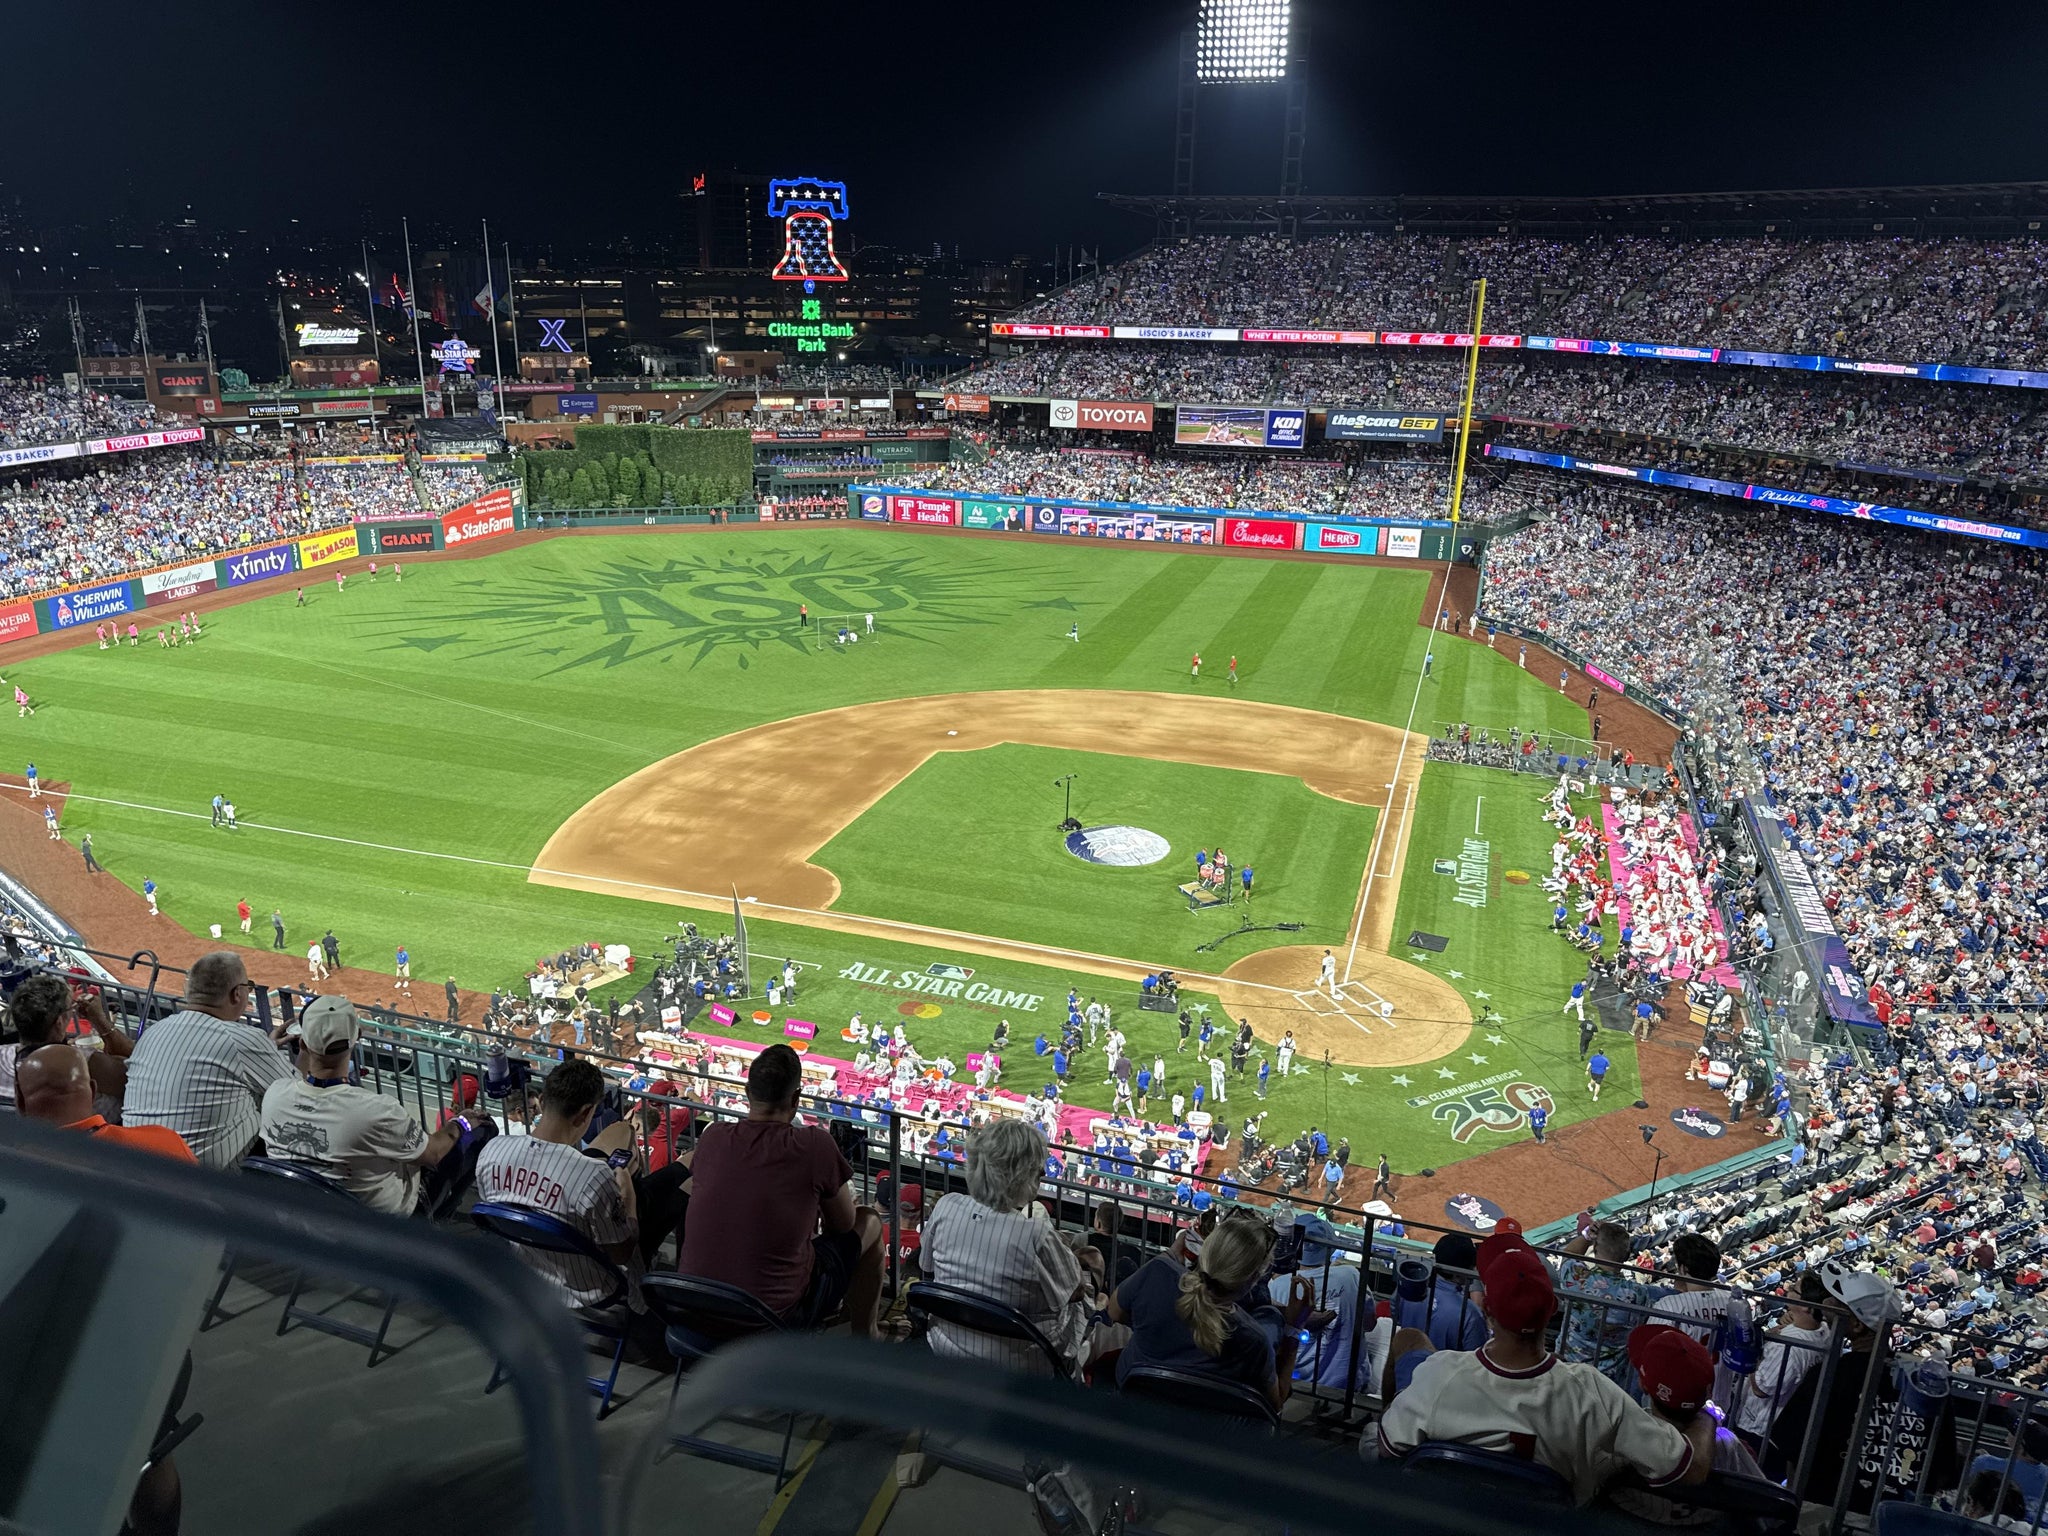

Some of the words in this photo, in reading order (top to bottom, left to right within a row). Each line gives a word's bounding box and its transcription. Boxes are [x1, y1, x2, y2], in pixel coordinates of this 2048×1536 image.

[299, 323, 360, 340] Fitzpatrick
[768, 323, 819, 337] Citizens
[822, 323, 854, 336] Bank
[1013, 326, 1037, 335] Phillies
[1038, 327, 1050, 335] win
[1065, 328, 1083, 336] Deals
[1085, 328, 1096, 336] roll
[1139, 329, 1175, 338] LISCIO'S
[1177, 330, 1213, 338] BAKERY
[1247, 332, 1271, 341] WHEY
[1272, 332, 1301, 341] BETTER
[1302, 333, 1336, 341] PROTEIN
[798, 339, 826, 351] Park
[1385, 334, 1412, 344] Coca-Cola
[1419, 334, 1446, 345] Coca-Cola
[1489, 335, 1517, 346] Coca-Cola
[1529, 339, 1547, 347] SWINGS
[431, 349, 444, 359] ALL
[445, 349, 461, 359] STAR
[462, 349, 481, 358] GAME
[162, 376, 204, 386] GIANT
[1081, 408, 1147, 424] TOYOTA
[1332, 415, 1399, 428] theScore
[1402, 419, 1434, 428] BET
[165, 429, 200, 442] TOYOTA
[108, 437, 147, 450] TOYOTA
[16, 449, 55, 461] BAKERY
[1758, 490, 1808, 504] Philadelphia
[917, 501, 951, 512] Temple
[644, 517, 656, 525] 401
[917, 512, 949, 523] Health
[1912, 516, 1931, 525] Mobile
[381, 532, 433, 546] GIANT
[1324, 532, 1356, 545] HERR'S
[1393, 535, 1416, 543] WM
[2003, 530, 2021, 540] 2026
[250, 541, 281, 552] ASPLUNDH
[326, 536, 356, 557] MASON
[210, 549, 244, 560] ASPLUNDH
[292, 544, 300, 569] 374
[169, 558, 205, 571] ASPLUNDH
[231, 551, 287, 581] xfinity
[124, 566, 163, 579] ASPLUNDH
[157, 568, 203, 589] Yuengling
[77, 577, 117, 590] ASPLUNDH
[27, 588, 70, 602] ASPLUNDH
[73, 587, 122, 609] SHERWIN
[168, 585, 198, 600] LAGER
[567, 575, 919, 635] ASG
[0, 613, 31, 628] WEBB
[1457, 838, 1490, 863] GAME
[1455, 862, 1488, 888] STAR
[1452, 886, 1487, 908] ALL
[838, 961, 889, 986] ALL
[893, 970, 965, 998] STAR
[964, 982, 1045, 1012] GAME
[859, 983, 955, 1005] PHILADELPHIA
[717, 1010, 731, 1022] Mobile
[793, 1025, 812, 1034] Mobile
[1428, 1081, 1482, 1102] CELEBRATING
[1482, 1070, 1523, 1087] AMERICA'S
[1525, 1086, 1549, 1100] TH
[1432, 1082, 1556, 1144] 250
[492, 1164, 563, 1210] HARPER
